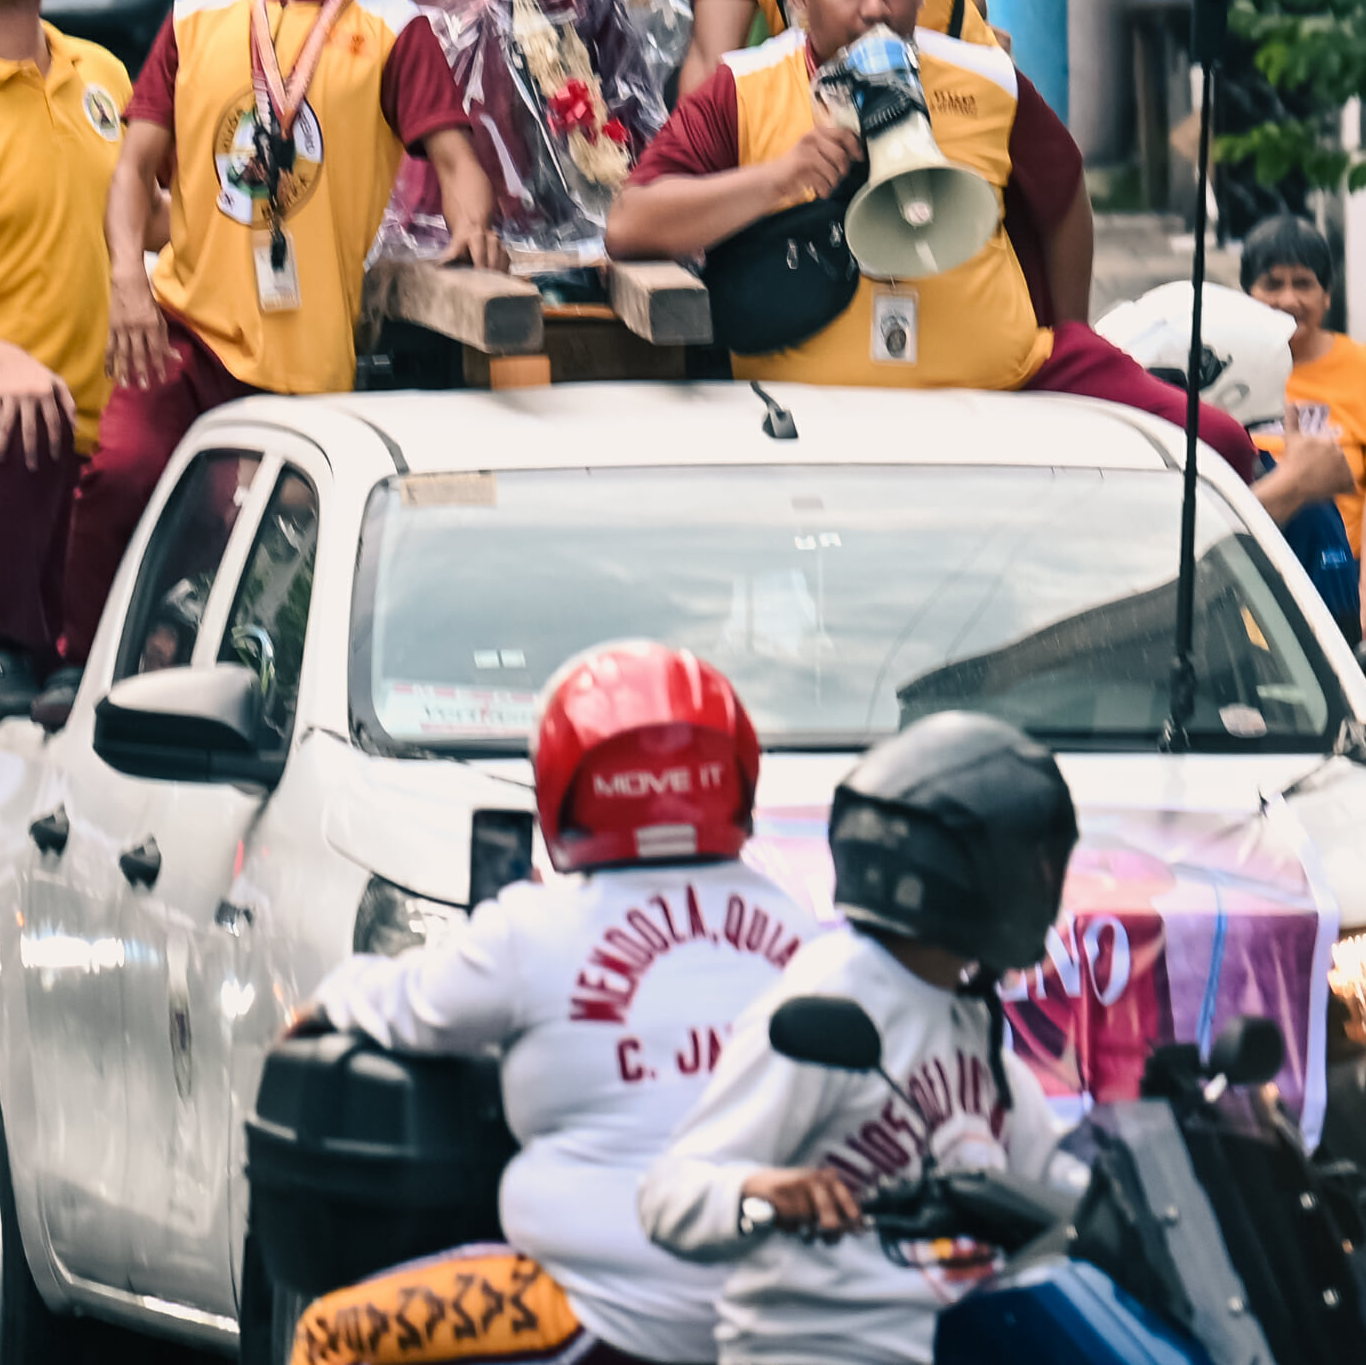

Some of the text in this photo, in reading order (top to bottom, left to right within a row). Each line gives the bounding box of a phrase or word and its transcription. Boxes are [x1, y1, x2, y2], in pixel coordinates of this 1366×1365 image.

[593, 761, 722, 796] MOVE IT
[724, 892, 801, 970] QUIA
